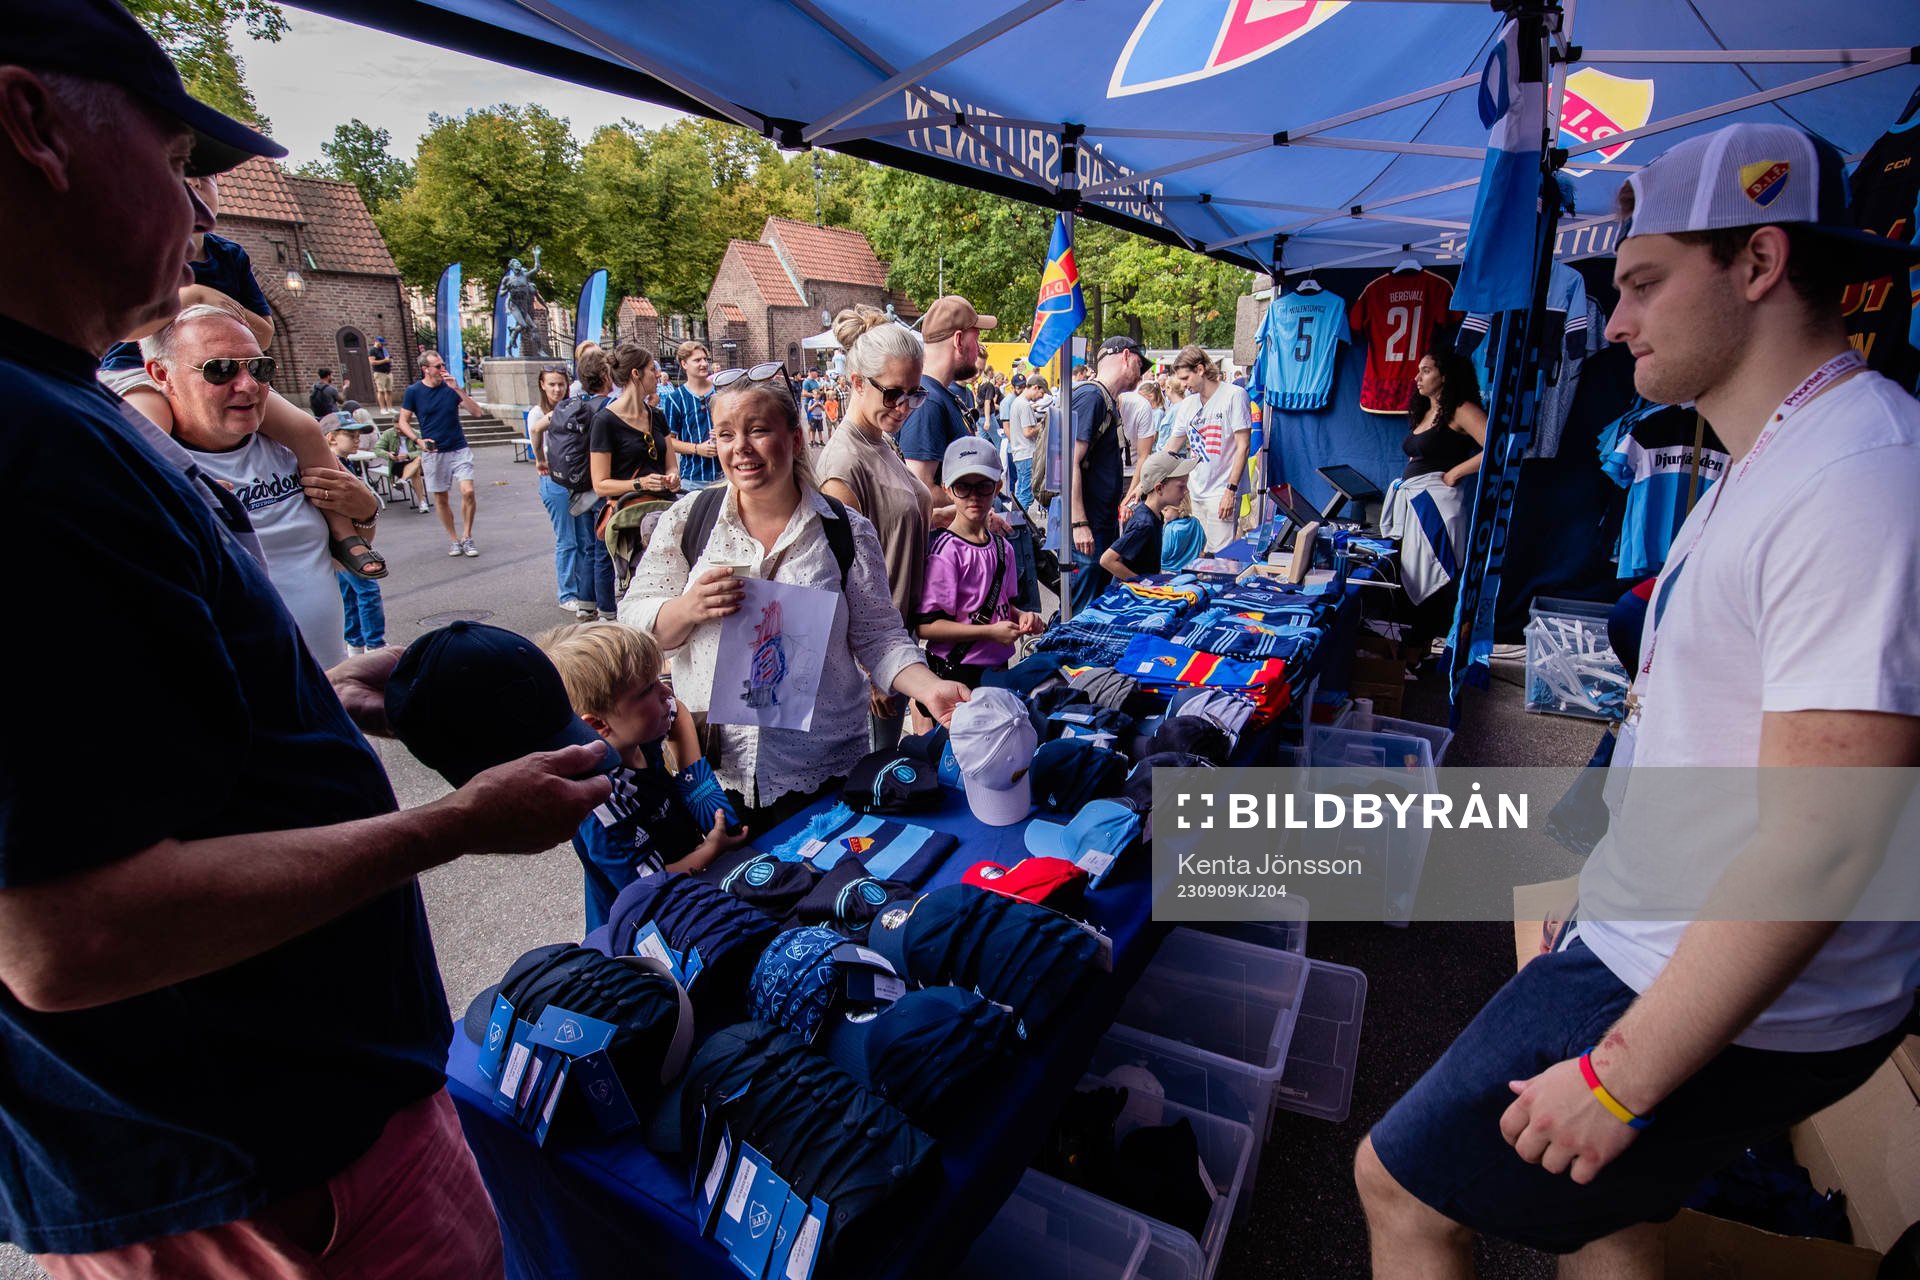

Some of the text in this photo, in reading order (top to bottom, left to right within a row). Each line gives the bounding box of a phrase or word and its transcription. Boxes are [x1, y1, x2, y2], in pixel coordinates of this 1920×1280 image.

[1884, 157, 1911, 172] CCM
[1389, 290, 1424, 303] BERGVALL
[1295, 316, 1315, 363] 5
[1385, 305, 1422, 362] 21
